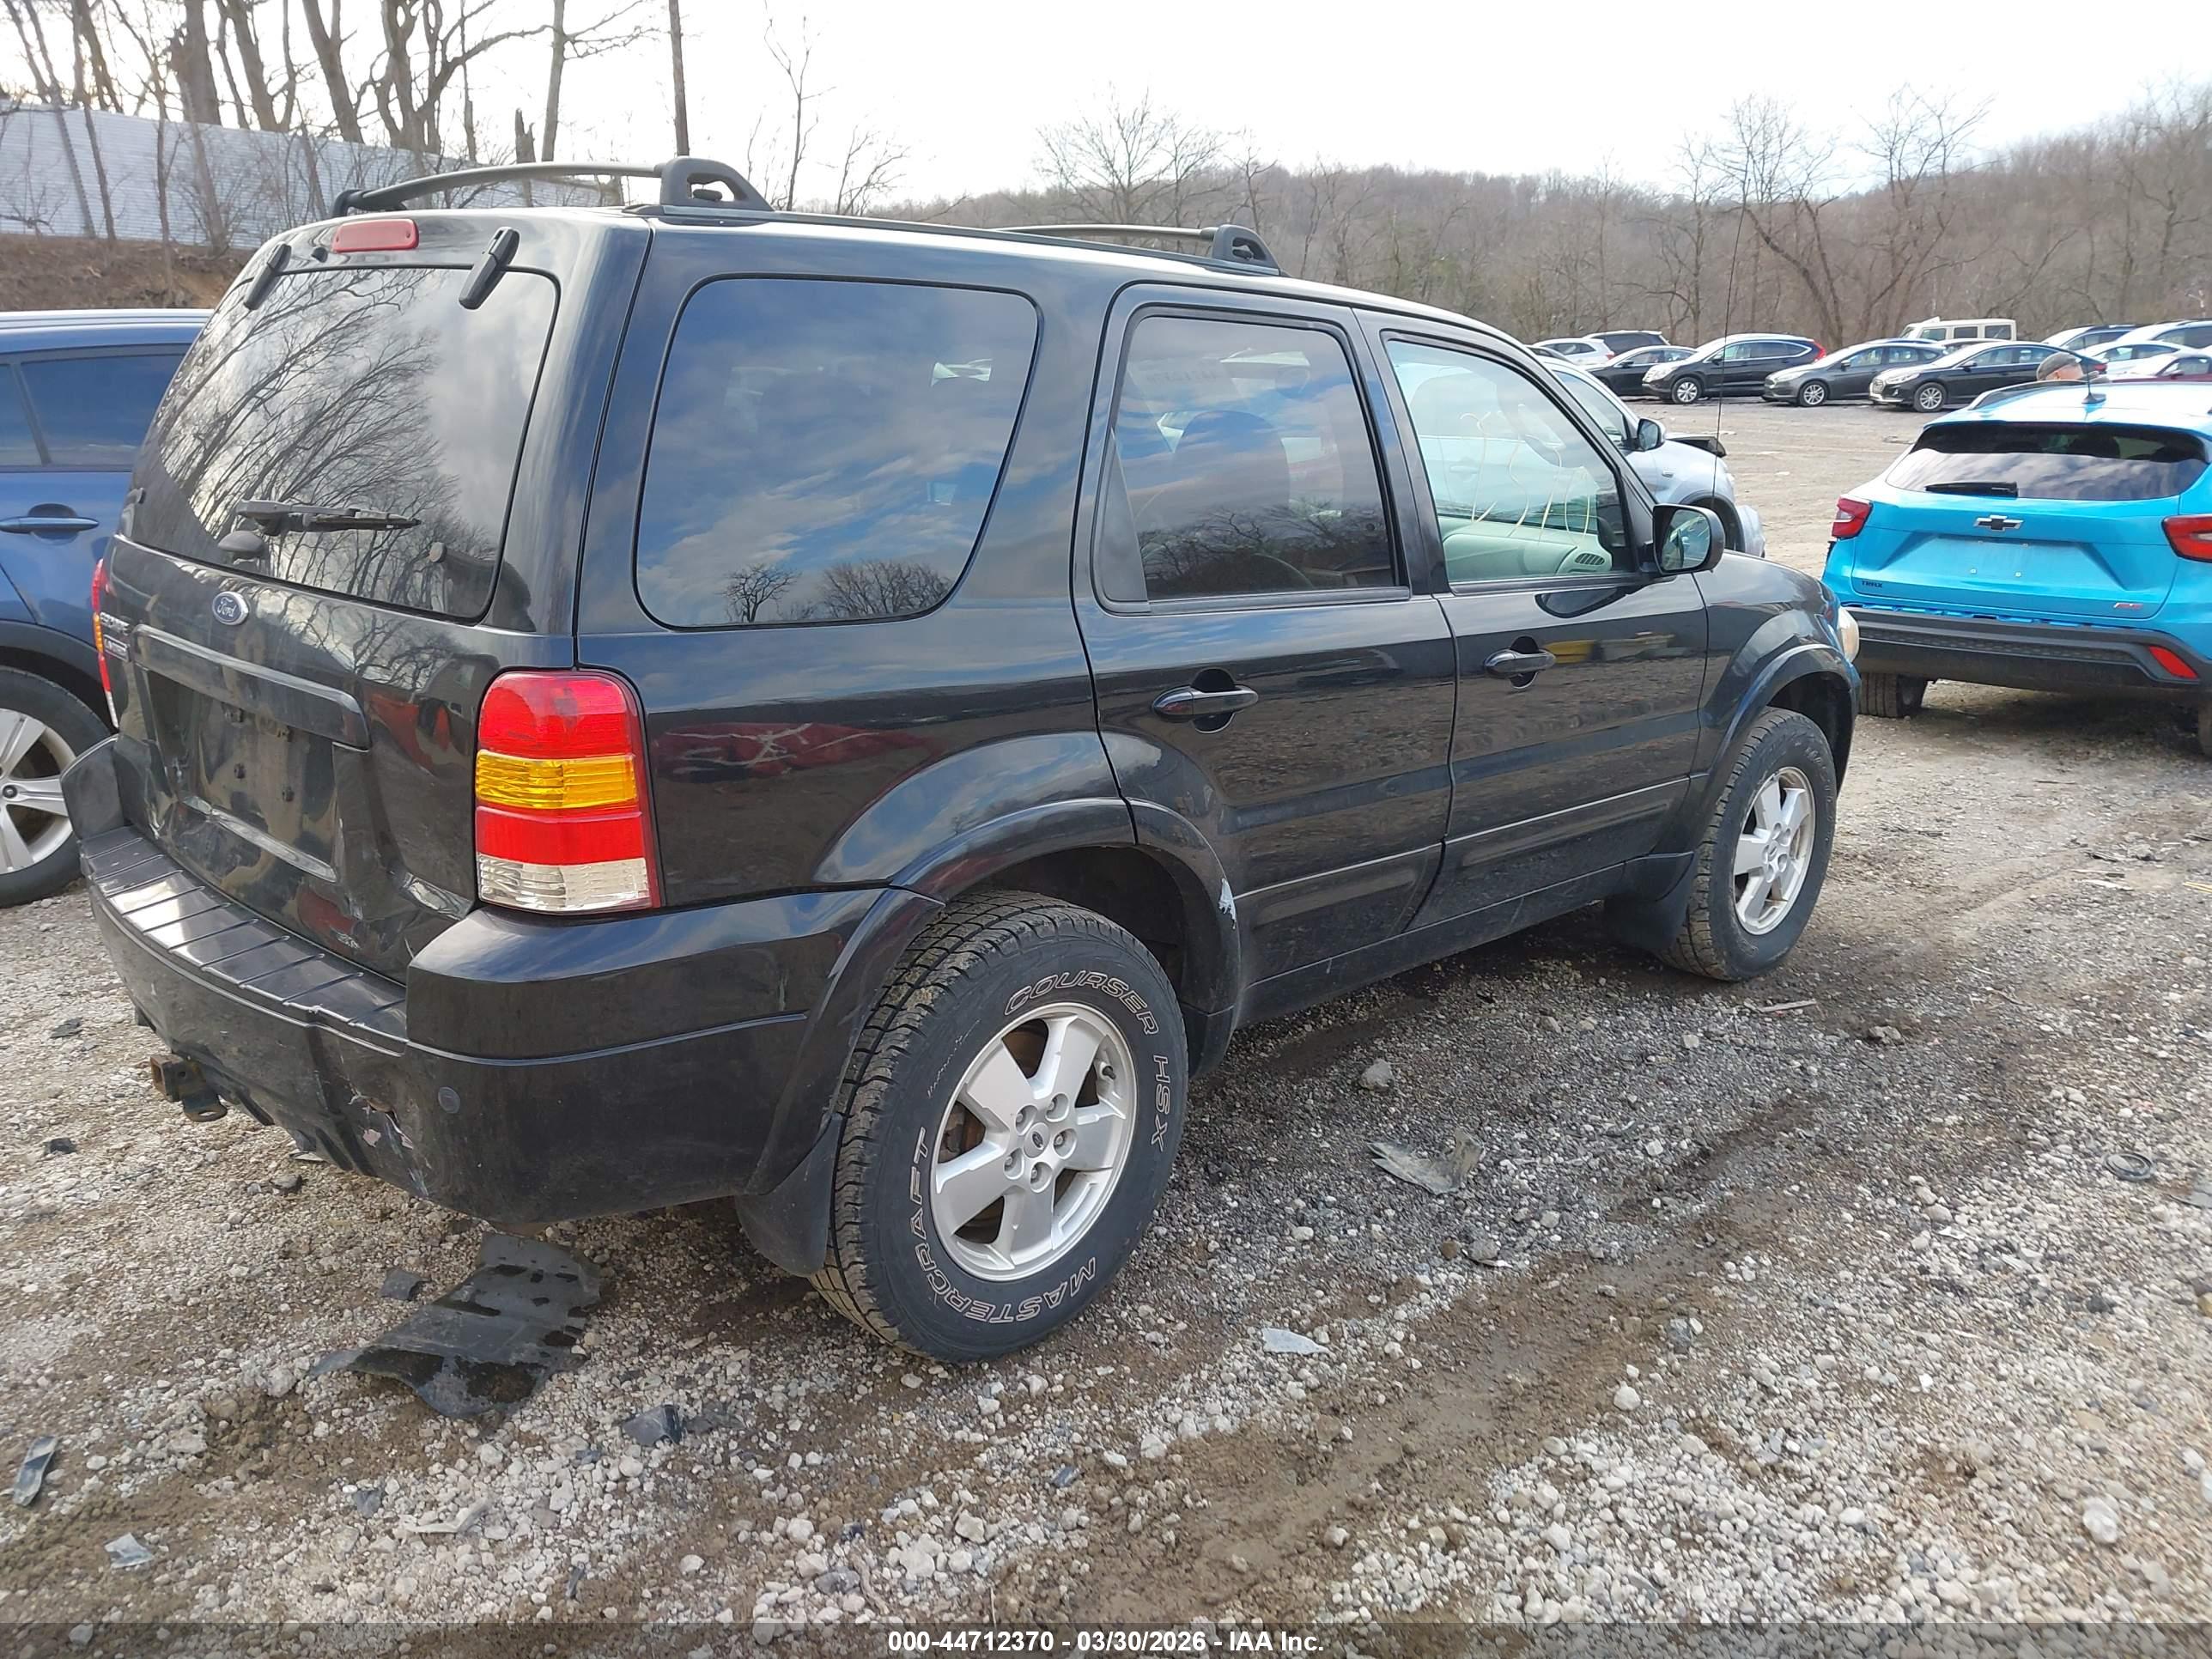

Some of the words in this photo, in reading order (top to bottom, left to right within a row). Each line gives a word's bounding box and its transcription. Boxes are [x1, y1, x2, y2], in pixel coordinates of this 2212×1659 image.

[1005, 969, 1159, 1036] COURSER
[1150, 1054, 1171, 1152] HSX
[908, 1127, 1097, 1324] MASTERCRAFT
